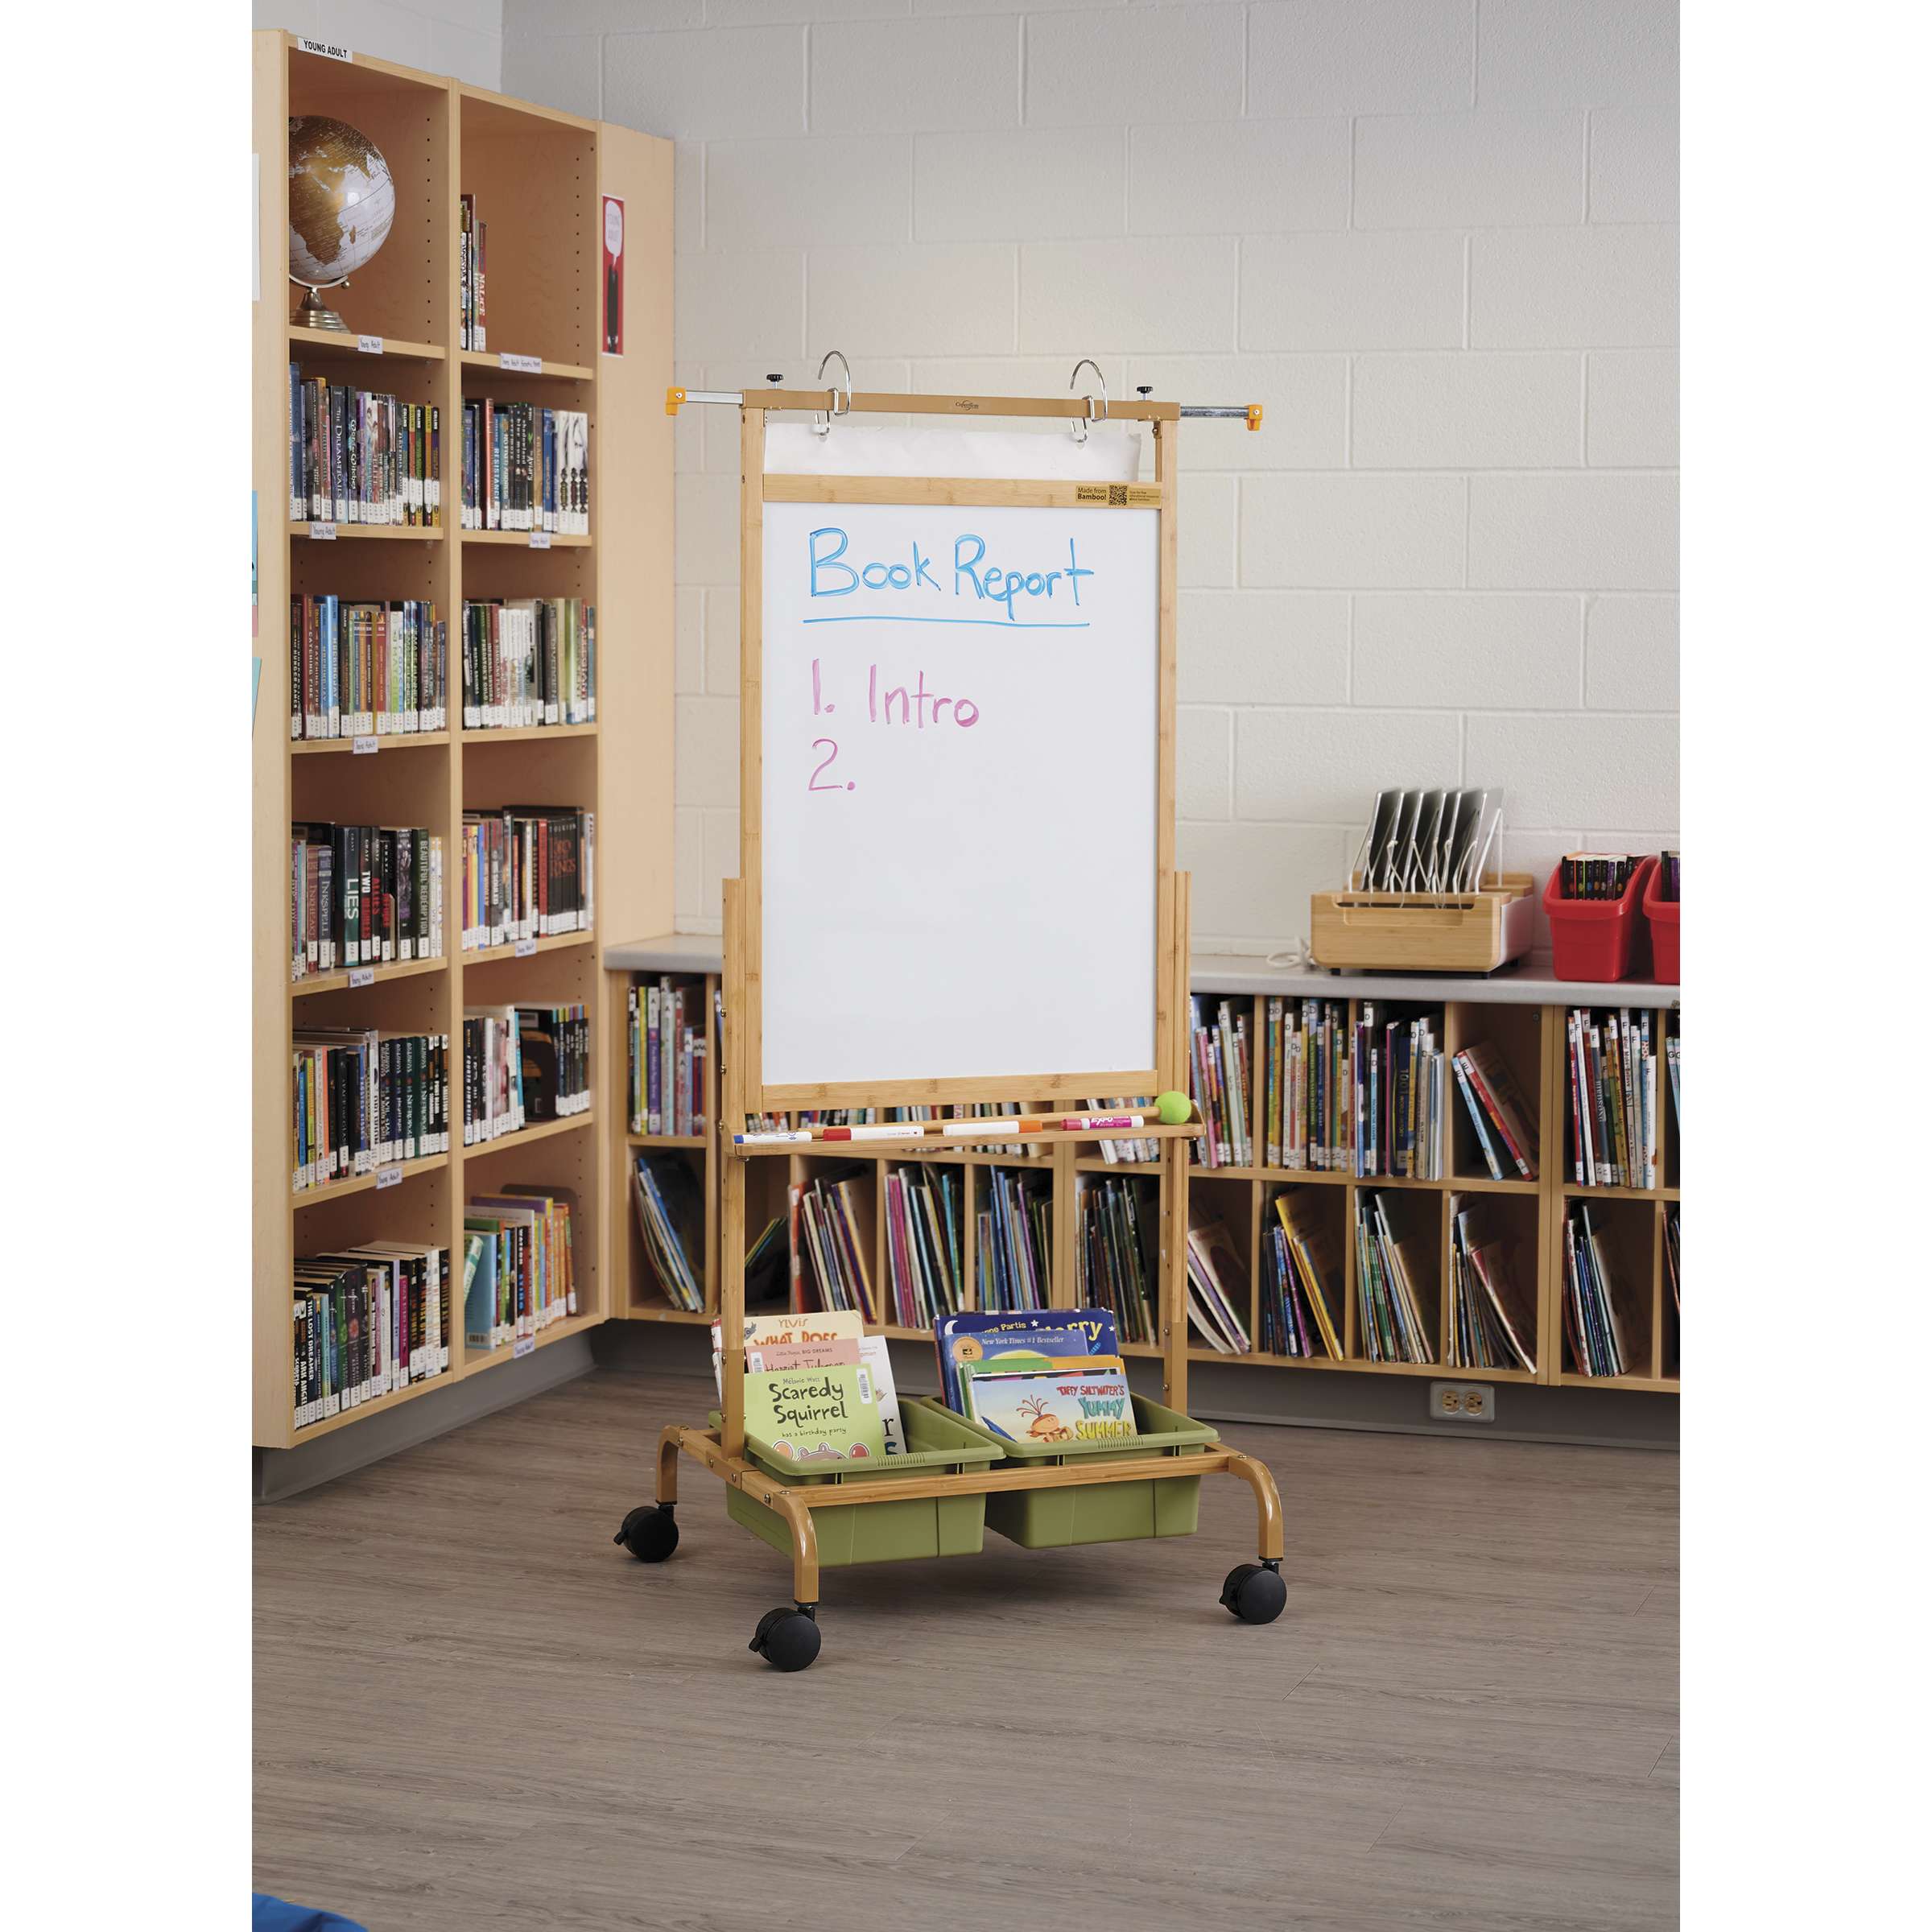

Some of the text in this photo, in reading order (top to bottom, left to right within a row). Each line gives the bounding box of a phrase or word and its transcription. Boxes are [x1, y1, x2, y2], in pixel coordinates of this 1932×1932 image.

[304, 39, 347, 58] YOUNG ADULT
[1077, 493, 1107, 501] Bamboo!
[809, 526, 1095, 621] Book Report
[811, 658, 980, 729] 1. Intro
[808, 737, 856, 791] 2.
[361, 870, 370, 894] TWO
[420, 840, 428, 935] BEAUTIFUL REDEMPTION
[320, 880, 329, 936] INKSPELL
[347, 877, 358, 920] LIES
[372, 877, 380, 915] ALLIES
[1001, 1321, 1026, 1331] Partis
[753, 1332, 792, 1346] WHAT
[769, 1377, 844, 1402] Scaredy
[1056, 1385, 1125, 1397] TAFFY SALTWATER'S
[774, 1401, 848, 1428] Squirrel
[1077, 1397, 1125, 1419] YUMMY
[799, 1428, 828, 1437] birthday
[1075, 1421, 1132, 1439] SUMMER
